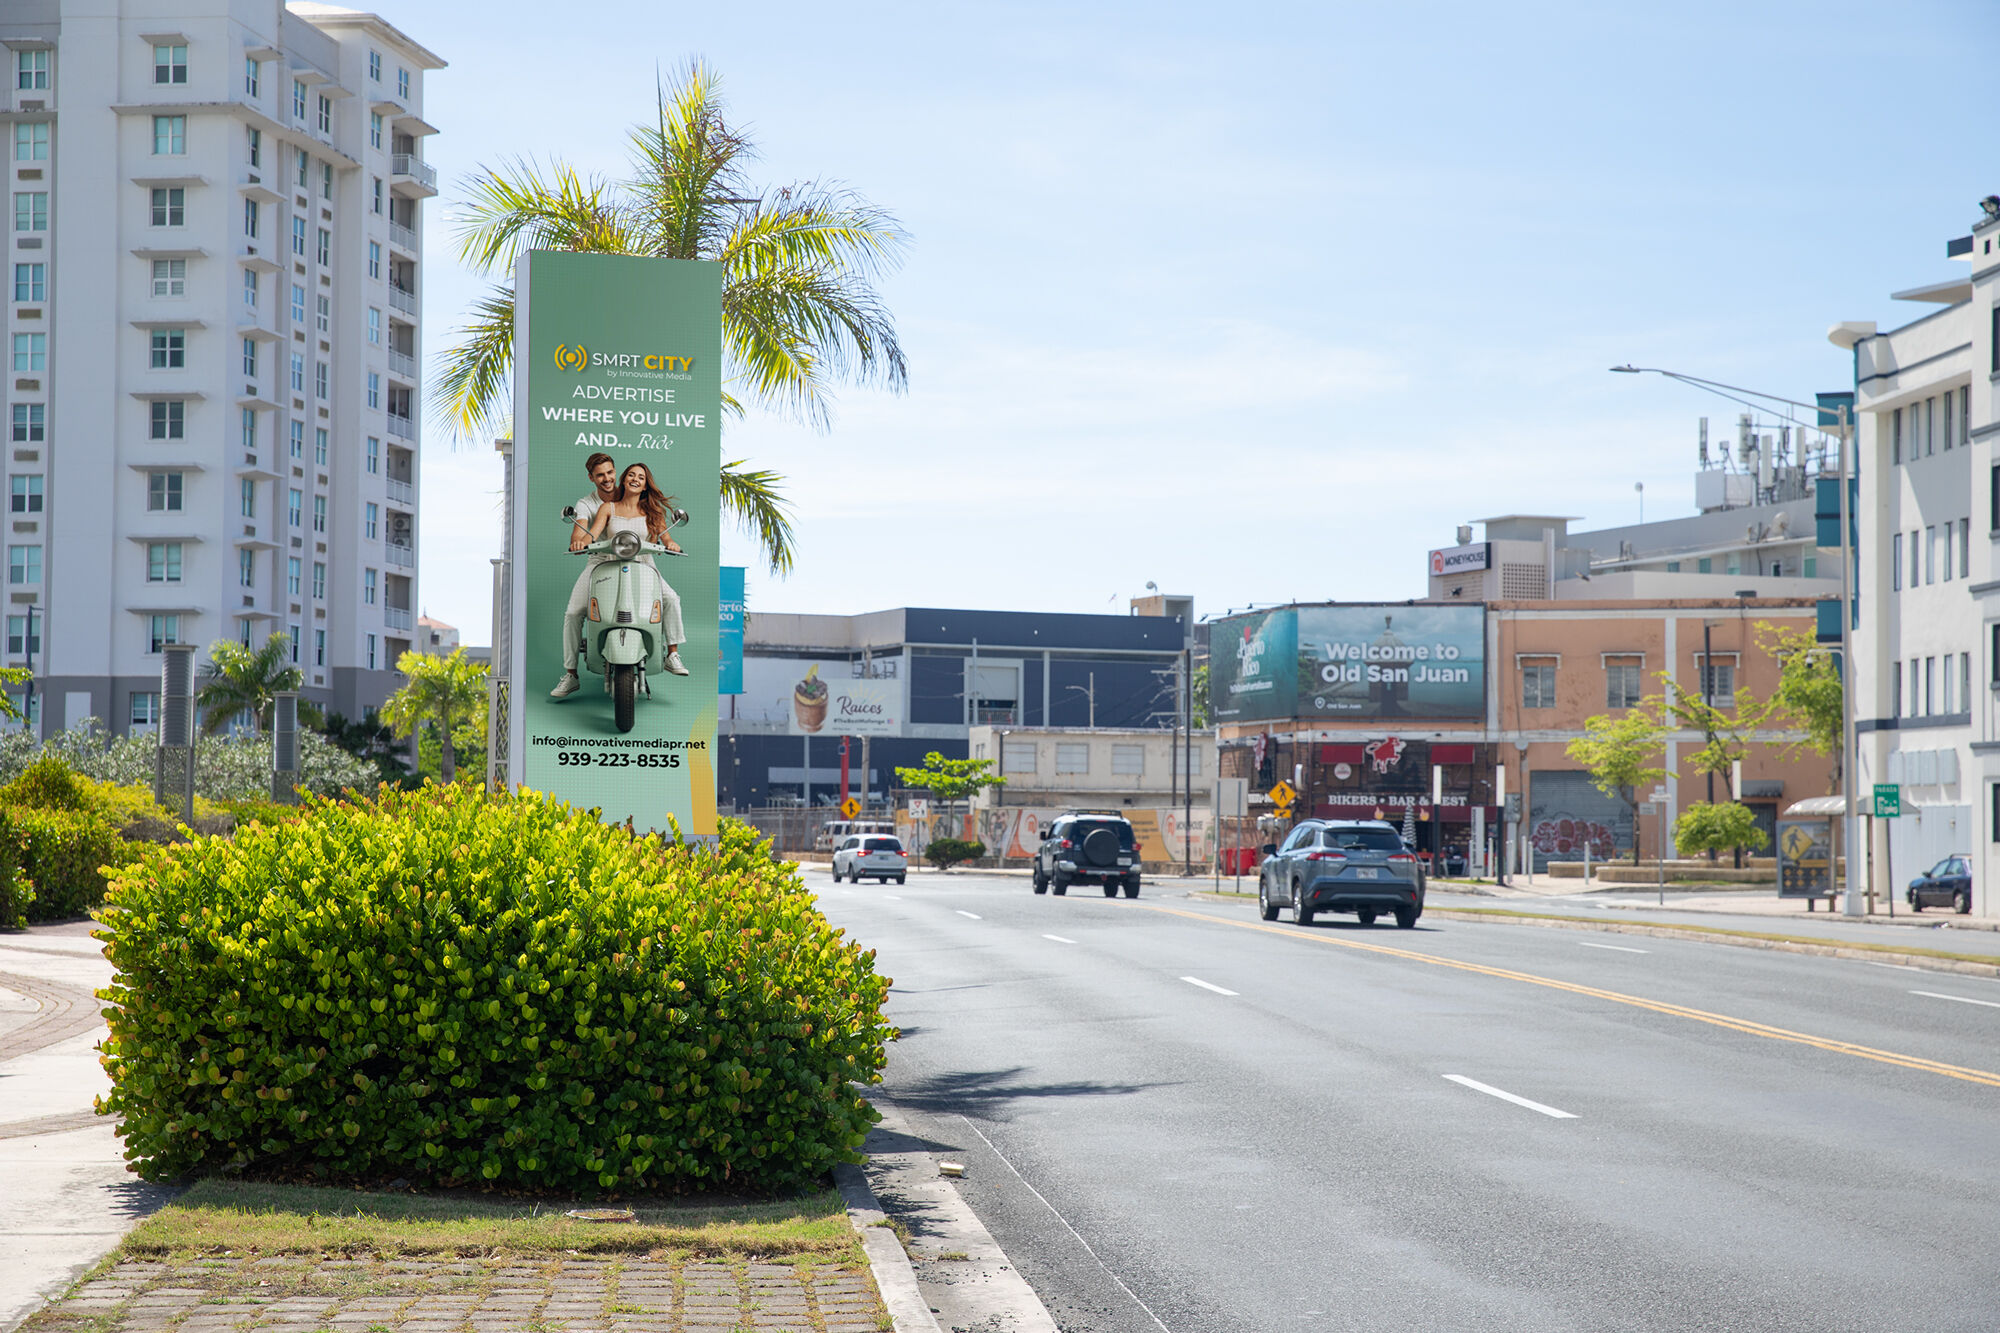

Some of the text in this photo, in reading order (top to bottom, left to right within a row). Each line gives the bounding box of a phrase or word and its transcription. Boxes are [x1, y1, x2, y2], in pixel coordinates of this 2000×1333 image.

[592, 352, 694, 371] SMRT CITY
[607, 369, 692, 381] by Innovative Media
[572, 385, 676, 404] ADVERTISE
[542, 406, 706, 428] WHERE YOU LIVE
[575, 432, 674, 450] AND... Ride
[718, 602, 743, 612] erto
[1325, 642, 1460, 661] Welcome to
[1321, 664, 1469, 683] Old San Juan
[532, 735, 706, 750] info@innovativemediapr.net
[558, 752, 680, 768] 939-223-8535
[1327, 794, 1467, 806] BIKERS BAR & EST
